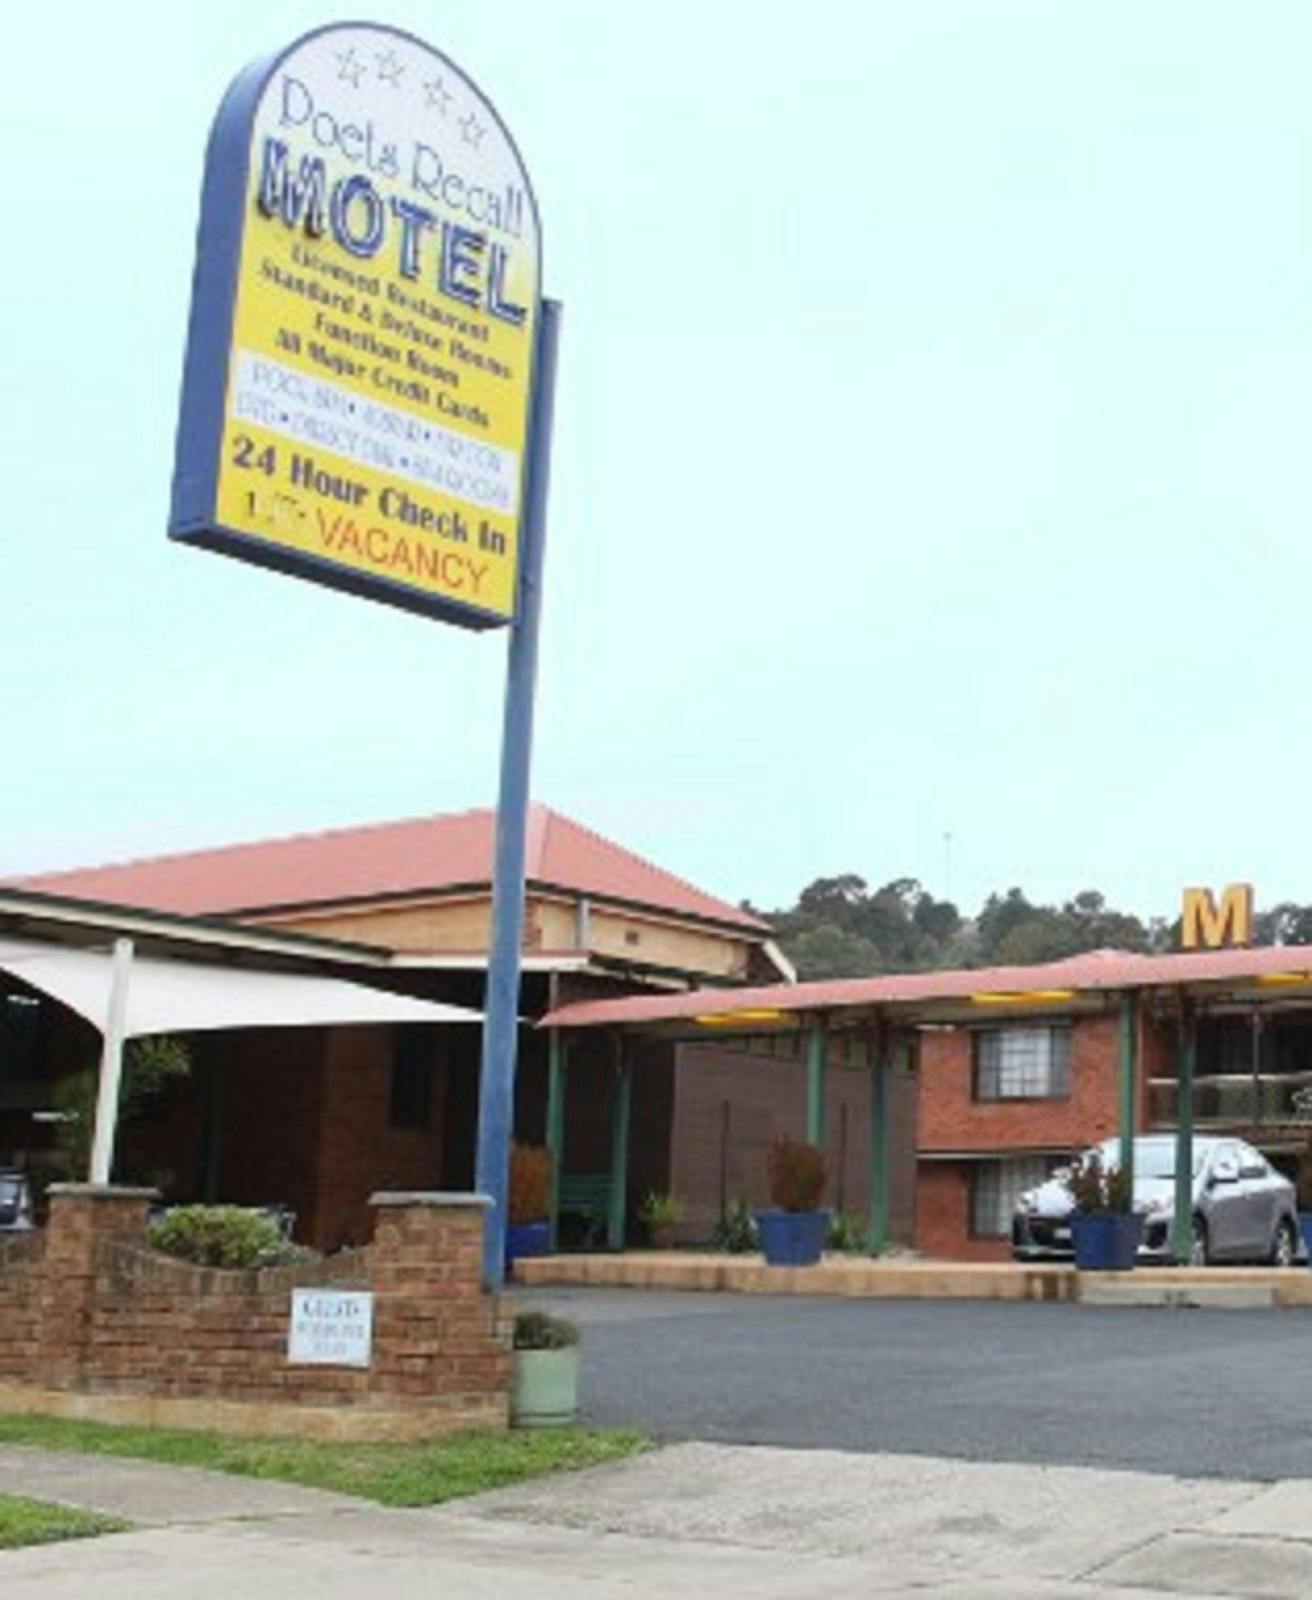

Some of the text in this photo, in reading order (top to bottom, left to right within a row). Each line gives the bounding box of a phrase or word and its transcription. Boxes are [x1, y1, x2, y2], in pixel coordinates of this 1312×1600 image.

[257, 133, 528, 328] MOTEL
[257, 256, 354, 314] Standard
[314, 311, 401, 363] Function
[231, 435, 276, 476] 24
[290, 451, 369, 507] Hour
[378, 486, 469, 543] Check
[478, 518, 506, 556] In
[315, 507, 490, 594] VACANCY
